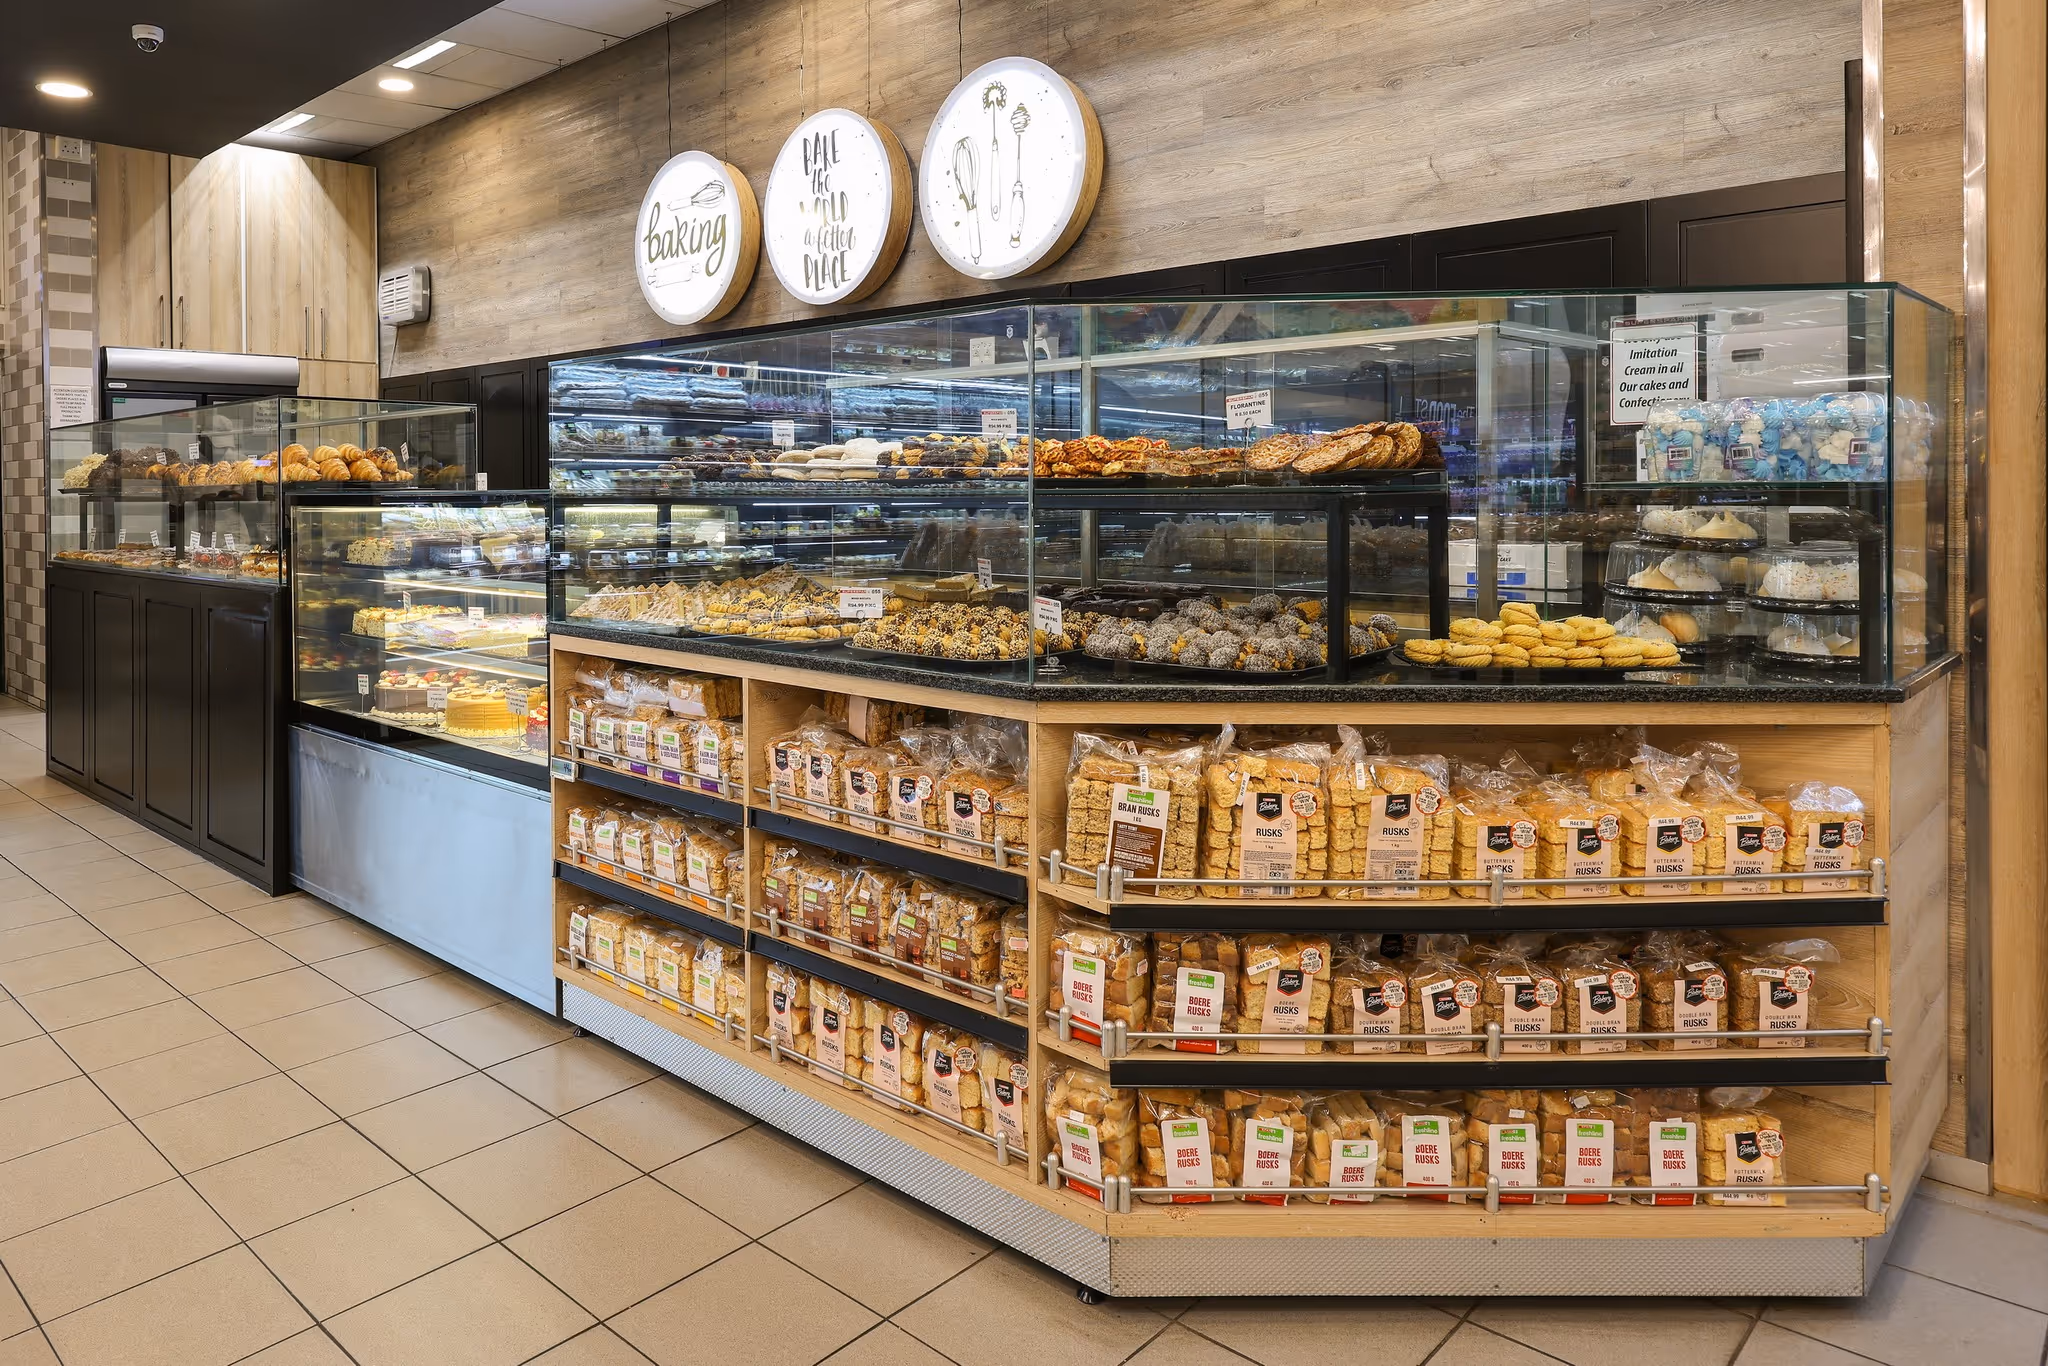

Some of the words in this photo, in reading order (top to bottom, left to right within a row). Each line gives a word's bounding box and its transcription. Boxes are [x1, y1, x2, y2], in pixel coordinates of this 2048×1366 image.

[803, 128, 840, 176] BAKE
[812, 168, 830, 196] the
[643, 201, 727, 277] baking
[803, 250, 851, 292] PLACE
[1629, 348, 1677, 359] Imitation
[1625, 365, 1655, 376] Cream
[1658, 363, 1667, 374] in
[1670, 362, 1684, 373] all
[1620, 382, 1637, 392] Our
[1640, 380, 1666, 391] cakes
[1669, 378, 1689, 389] and
[1231, 400, 1265, 410] FLORANTINE
[811, 789, 824, 798] RUSKS
[854, 804, 869, 813] RUSKS
[1118, 802, 1136, 813] BRAN
[1138, 805, 1160, 817] RUSKS
[1259, 801, 1280, 811] Bakery
[1388, 802, 1408, 812] Bakery
[900, 812, 917, 821] RUSKS
[955, 828, 975, 837] RUSKS
[1256, 828, 1283, 837] RUSKS
[1383, 828, 1409, 836] RUSKS
[1490, 836, 1511, 846] Bakery
[1659, 835, 1681, 845] Bakery
[1739, 837, 1761, 847] Bakery
[1822, 834, 1841, 843] Bakery
[1580, 839, 1599, 849] Bakery
[1575, 867, 1602, 876] RUSKS
[1656, 864, 1683, 873] RUSKS
[1734, 866, 1761, 875] RUSKS
[941, 949, 953, 957] CHOCO
[941, 954, 953, 962] RUSKS
[1073, 980, 1093, 993] BOERE
[1188, 978, 1214, 988] freshline
[1280, 978, 1300, 987] Bakery
[1072, 990, 1093, 1004] RUSKS
[1773, 990, 1795, 999] Bakery
[1188, 996, 1211, 1007] BOERE
[1592, 995, 1613, 1005] Bakery
[1187, 1006, 1211, 1017] RUSKS
[1273, 1006, 1299, 1014] RUSKS
[1436, 1002, 1457, 1013] Bakery
[1514, 1023, 1540, 1032] RUSKS
[1683, 1018, 1708, 1028] RUSKS
[1770, 1021, 1797, 1030] RUSKS
[1363, 1025, 1390, 1034] RUSKS
[822, 1041, 839, 1052] RUSKS
[880, 1060, 895, 1072] RUSKS
[934, 1083, 952, 1096] RUSKS
[998, 1113, 1016, 1128] RUSKS
[1414, 1126, 1439, 1134] freshline
[1577, 1129, 1603, 1137] freshline
[1500, 1134, 1526, 1142] freshline
[1071, 1143, 1090, 1155] BOERE
[1177, 1148, 1198, 1158] BOERE
[1415, 1144, 1438, 1154] BOERE
[1579, 1148, 1601, 1157] BOERE
[1738, 1144, 1758, 1155] Bakery
[1072, 1151, 1091, 1164] RUSKS
[1258, 1150, 1279, 1159] BOERE
[1415, 1154, 1440, 1165] RUSKS
[1501, 1151, 1524, 1161] BOERE
[1663, 1150, 1684, 1160] BOERE
[1177, 1158, 1200, 1168] RUSKS
[1256, 1160, 1279, 1169] RUSKS
[1501, 1161, 1526, 1170] RUSKS
[1577, 1157, 1602, 1167] RUSKS
[1662, 1160, 1686, 1170] RUSKS
[1343, 1166, 1365, 1175] BOERE
[1341, 1174, 1364, 1183] RUSKS
[1736, 1175, 1763, 1183] RUSKS
